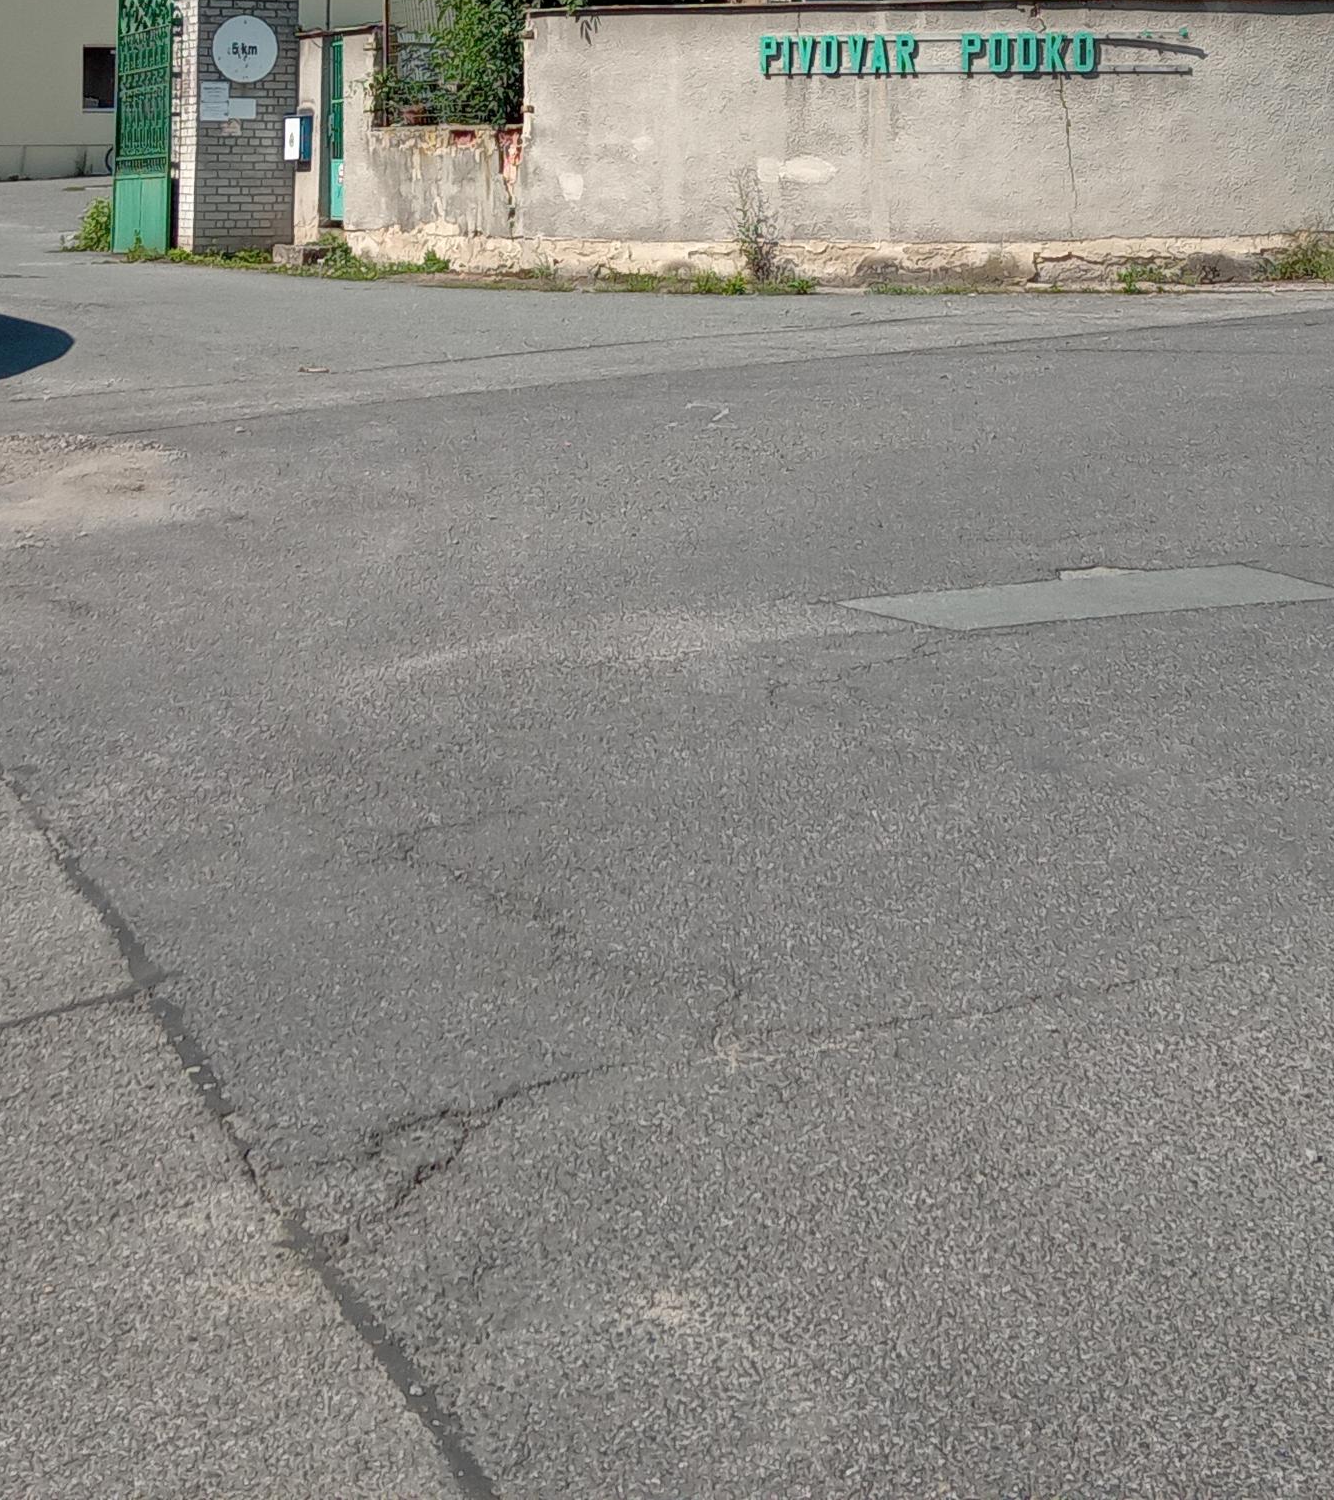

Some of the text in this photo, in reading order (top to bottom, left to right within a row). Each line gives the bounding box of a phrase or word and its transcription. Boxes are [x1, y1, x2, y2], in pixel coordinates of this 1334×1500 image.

[241, 41, 258, 55] km
[759, 31, 1096, 74] PIVOVAR PODKO
